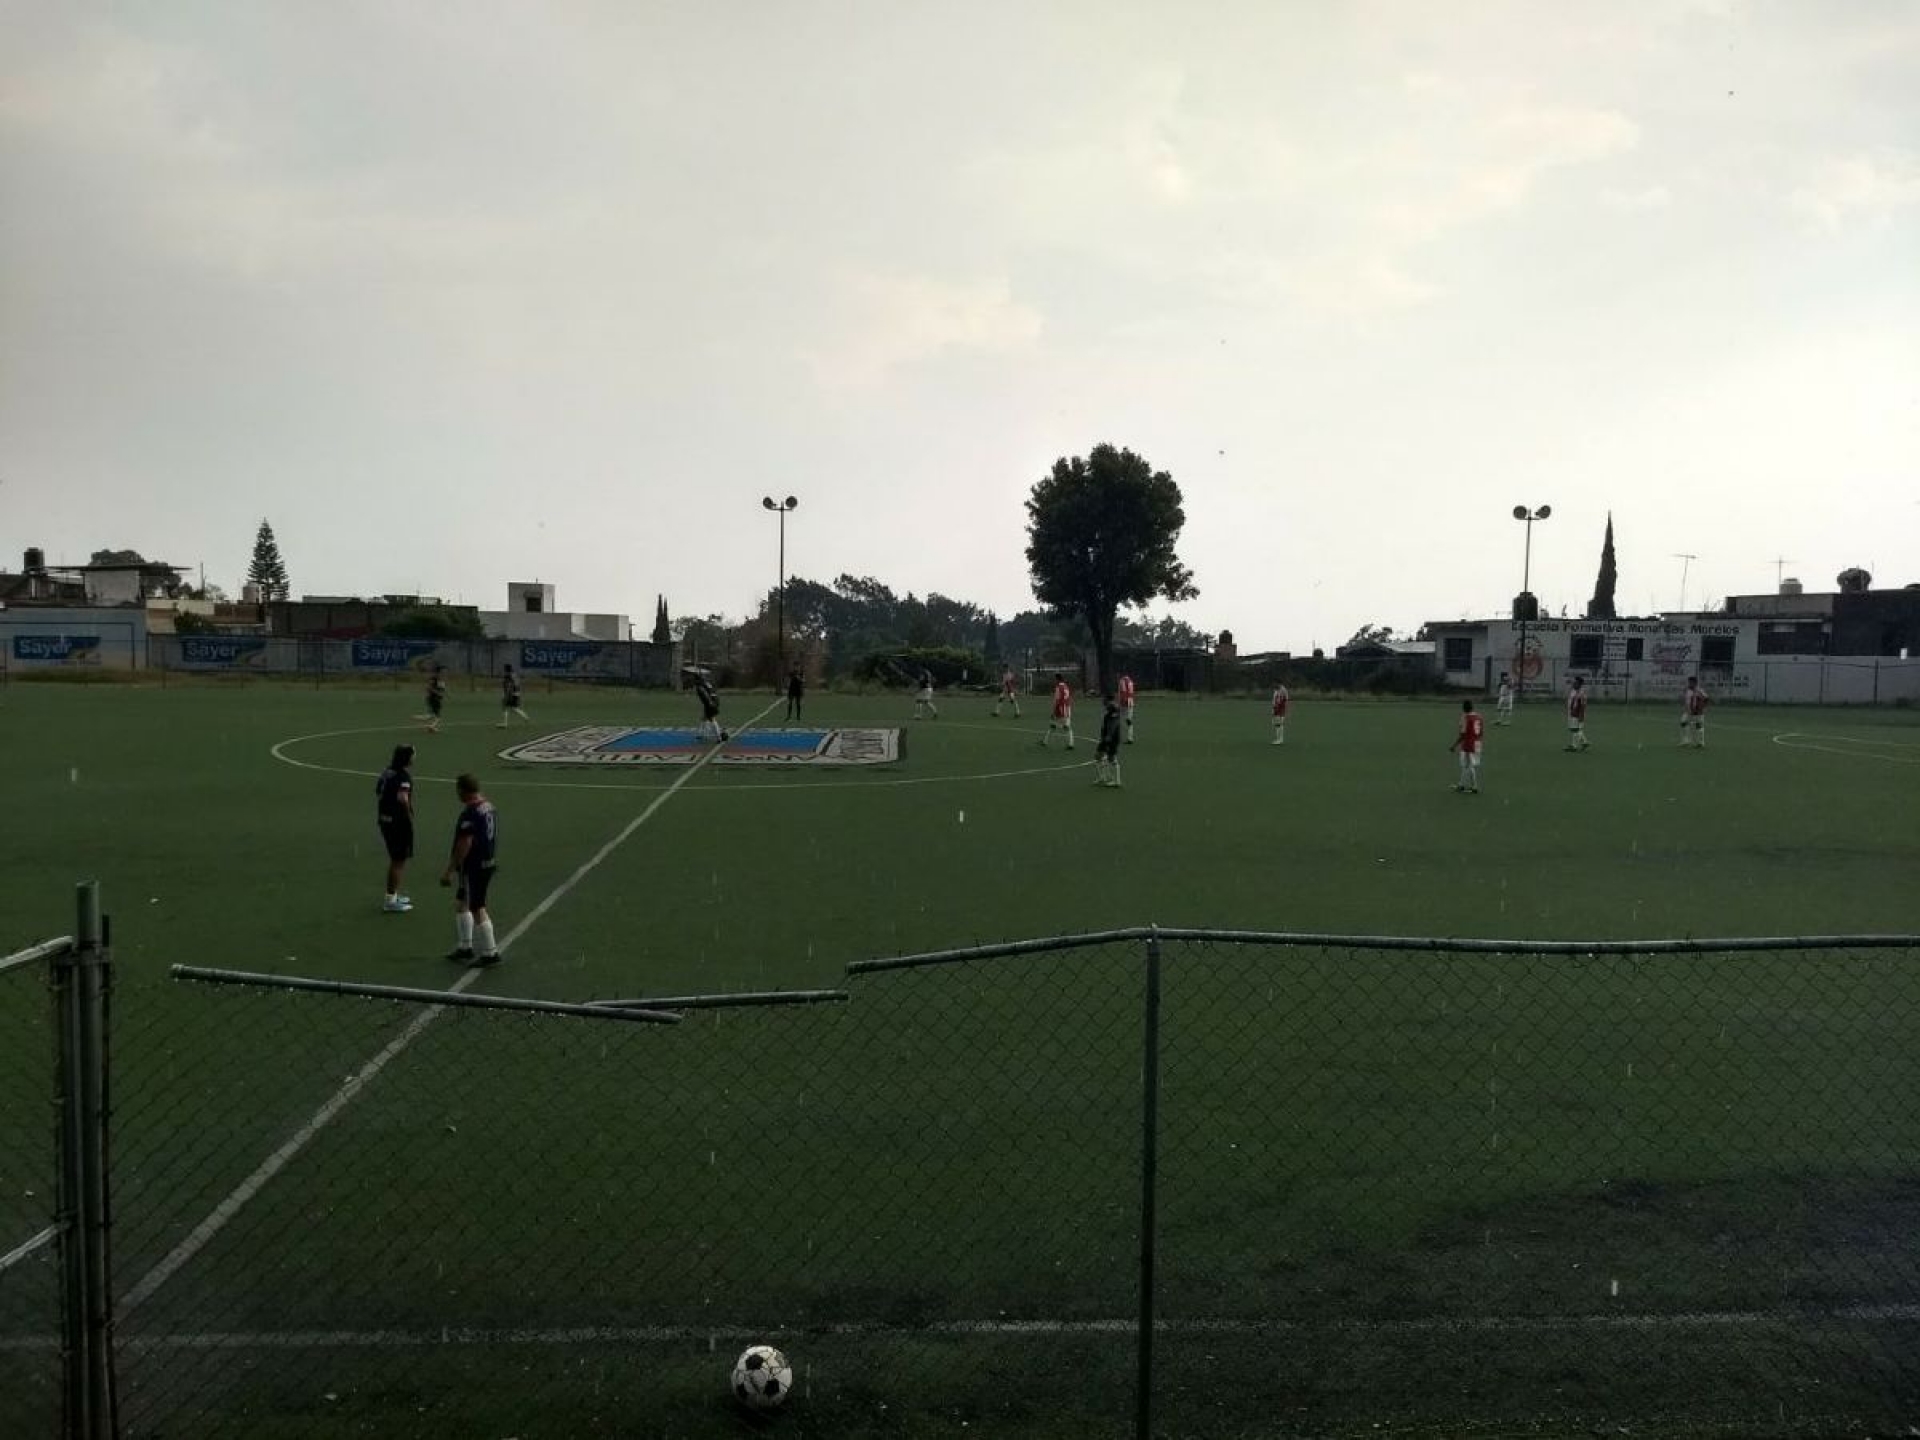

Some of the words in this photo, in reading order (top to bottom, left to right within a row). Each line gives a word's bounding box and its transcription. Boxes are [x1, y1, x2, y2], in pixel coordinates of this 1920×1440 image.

[1563, 621, 1624, 633] Formativa
[1629, 623, 1685, 634] Monarcas
[1690, 623, 1740, 635] Morelos
[19, 639, 73, 657] Sayer
[186, 642, 238, 658] Sayer
[358, 645, 410, 661] Sayer
[524, 647, 577, 664] Sayer
